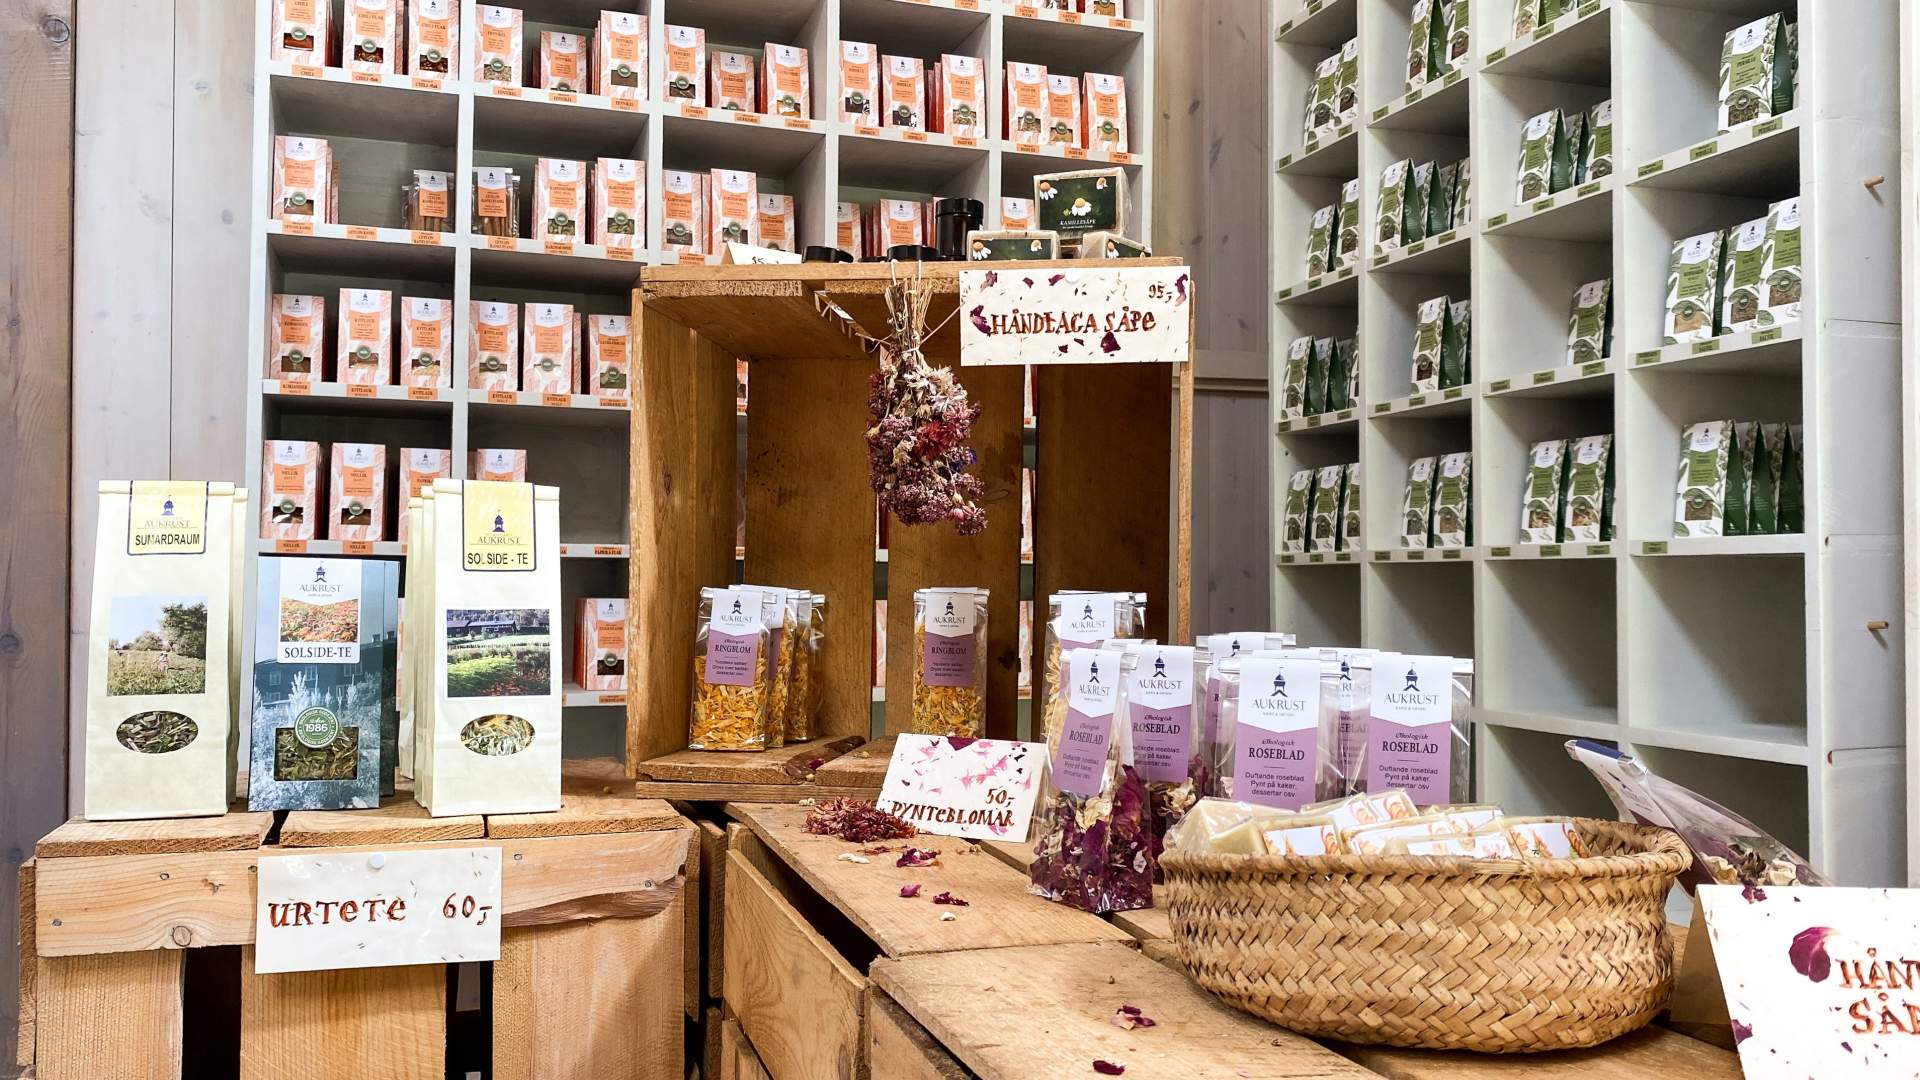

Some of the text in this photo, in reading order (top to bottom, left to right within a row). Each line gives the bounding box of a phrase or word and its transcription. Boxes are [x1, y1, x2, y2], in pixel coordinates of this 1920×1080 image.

[144, 519, 191, 529] AUKRUST
[135, 533, 200, 546] SUMARDRAUM
[478, 536, 521, 545] AUKRUST
[299, 583, 342, 593] AUKRUST
[284, 646, 352, 659] SOLSIDE-TE
[714, 644, 752, 654] RINGBLOM
[931, 646, 967, 655] RINGBLOM
[1137, 679, 1183, 690] AUKRUST
[1079, 684, 1110, 697] AUKRUST
[1252, 698, 1306, 711] AUKRUST
[1384, 693, 1439, 705] AUKRUST
[304, 723, 328, 733] 1986
[1132, 722, 1180, 735] ROSEBLAD
[1069, 730, 1104, 746] ROSEBLAD
[1382, 740, 1438, 754] ROSEBLAD
[1248, 747, 1305, 761] ROSEBLAD
[1244, 771, 1305, 782] Duftande roseblad
[1410, 767, 1439, 775] roseblad
[1385, 773, 1400, 781] Pynt
[1250, 780, 1266, 788] Pynt
